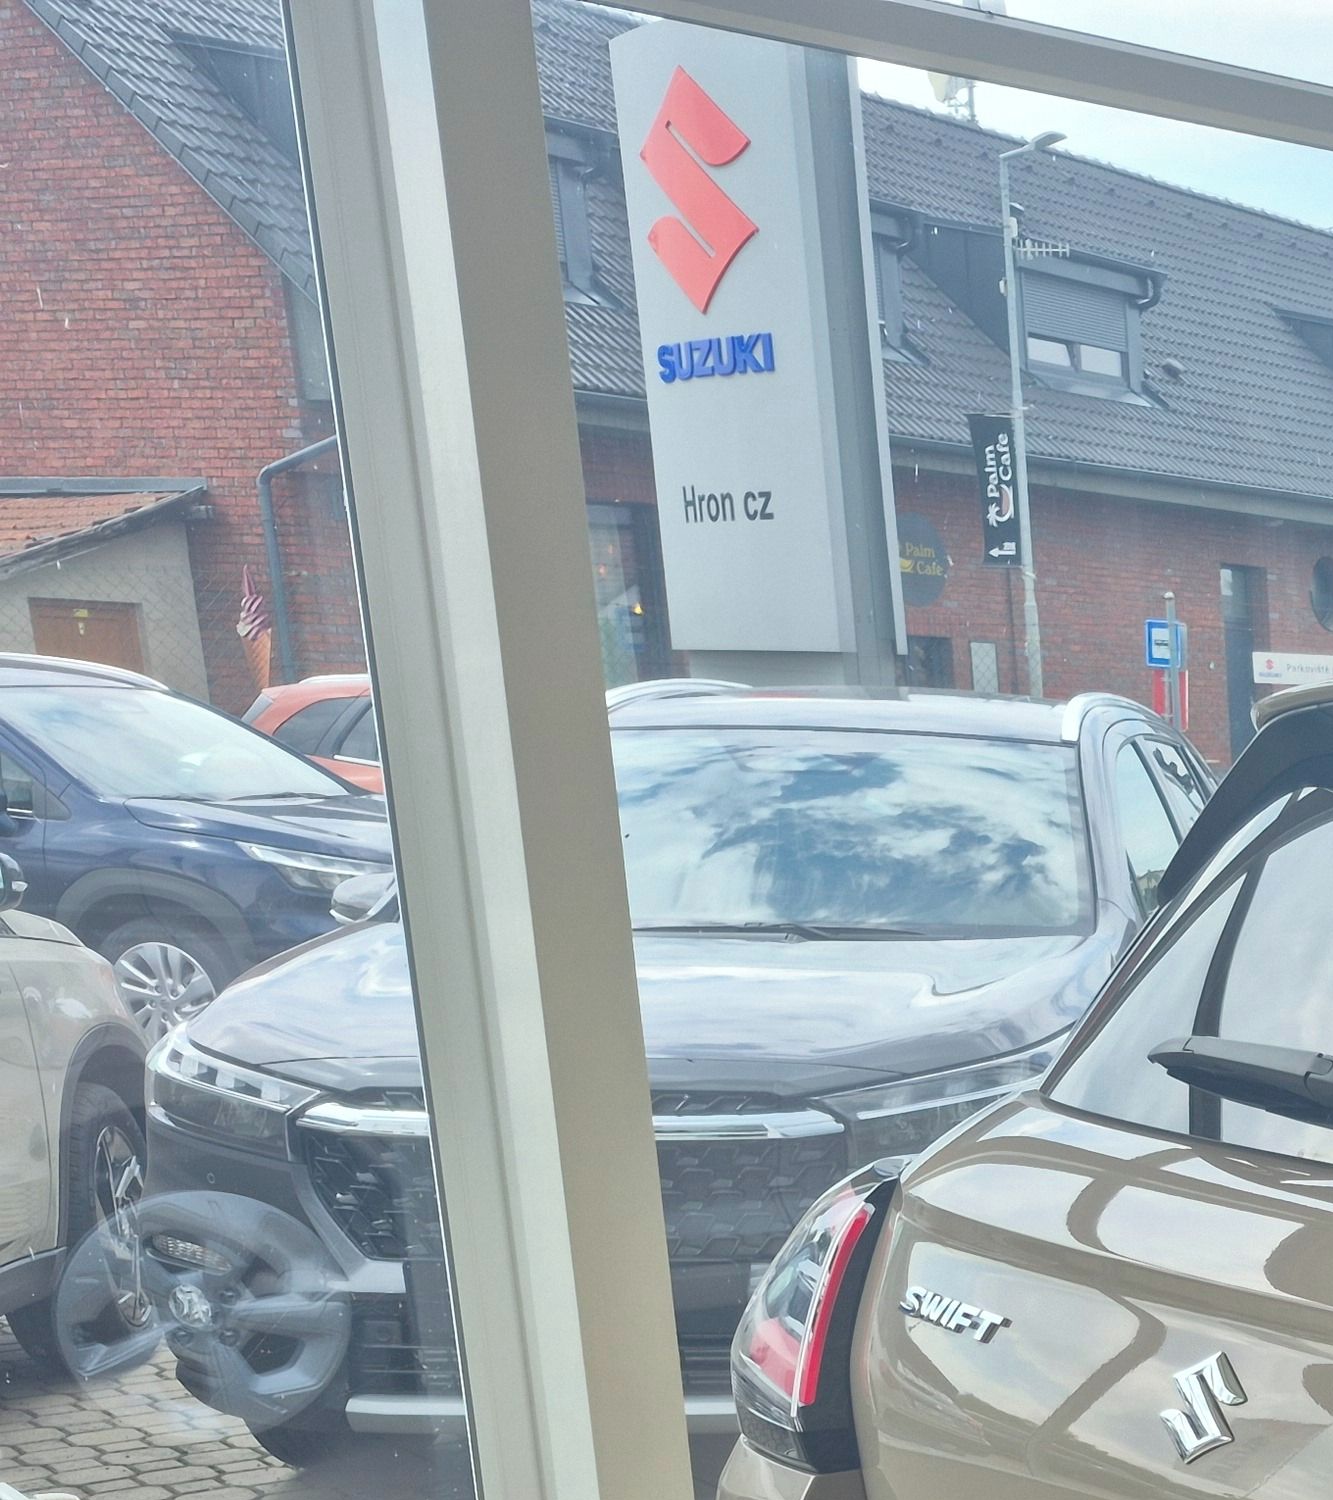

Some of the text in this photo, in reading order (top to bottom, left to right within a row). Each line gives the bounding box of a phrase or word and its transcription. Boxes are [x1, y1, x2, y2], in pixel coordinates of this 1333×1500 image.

[657, 332, 776, 384] SUZUKI
[984, 444, 1000, 498] Palm
[996, 433, 1012, 481] Cafe
[682, 484, 735, 523] Hron
[905, 542, 936, 558] Palm
[899, 1285, 1012, 1344] SWIFT
